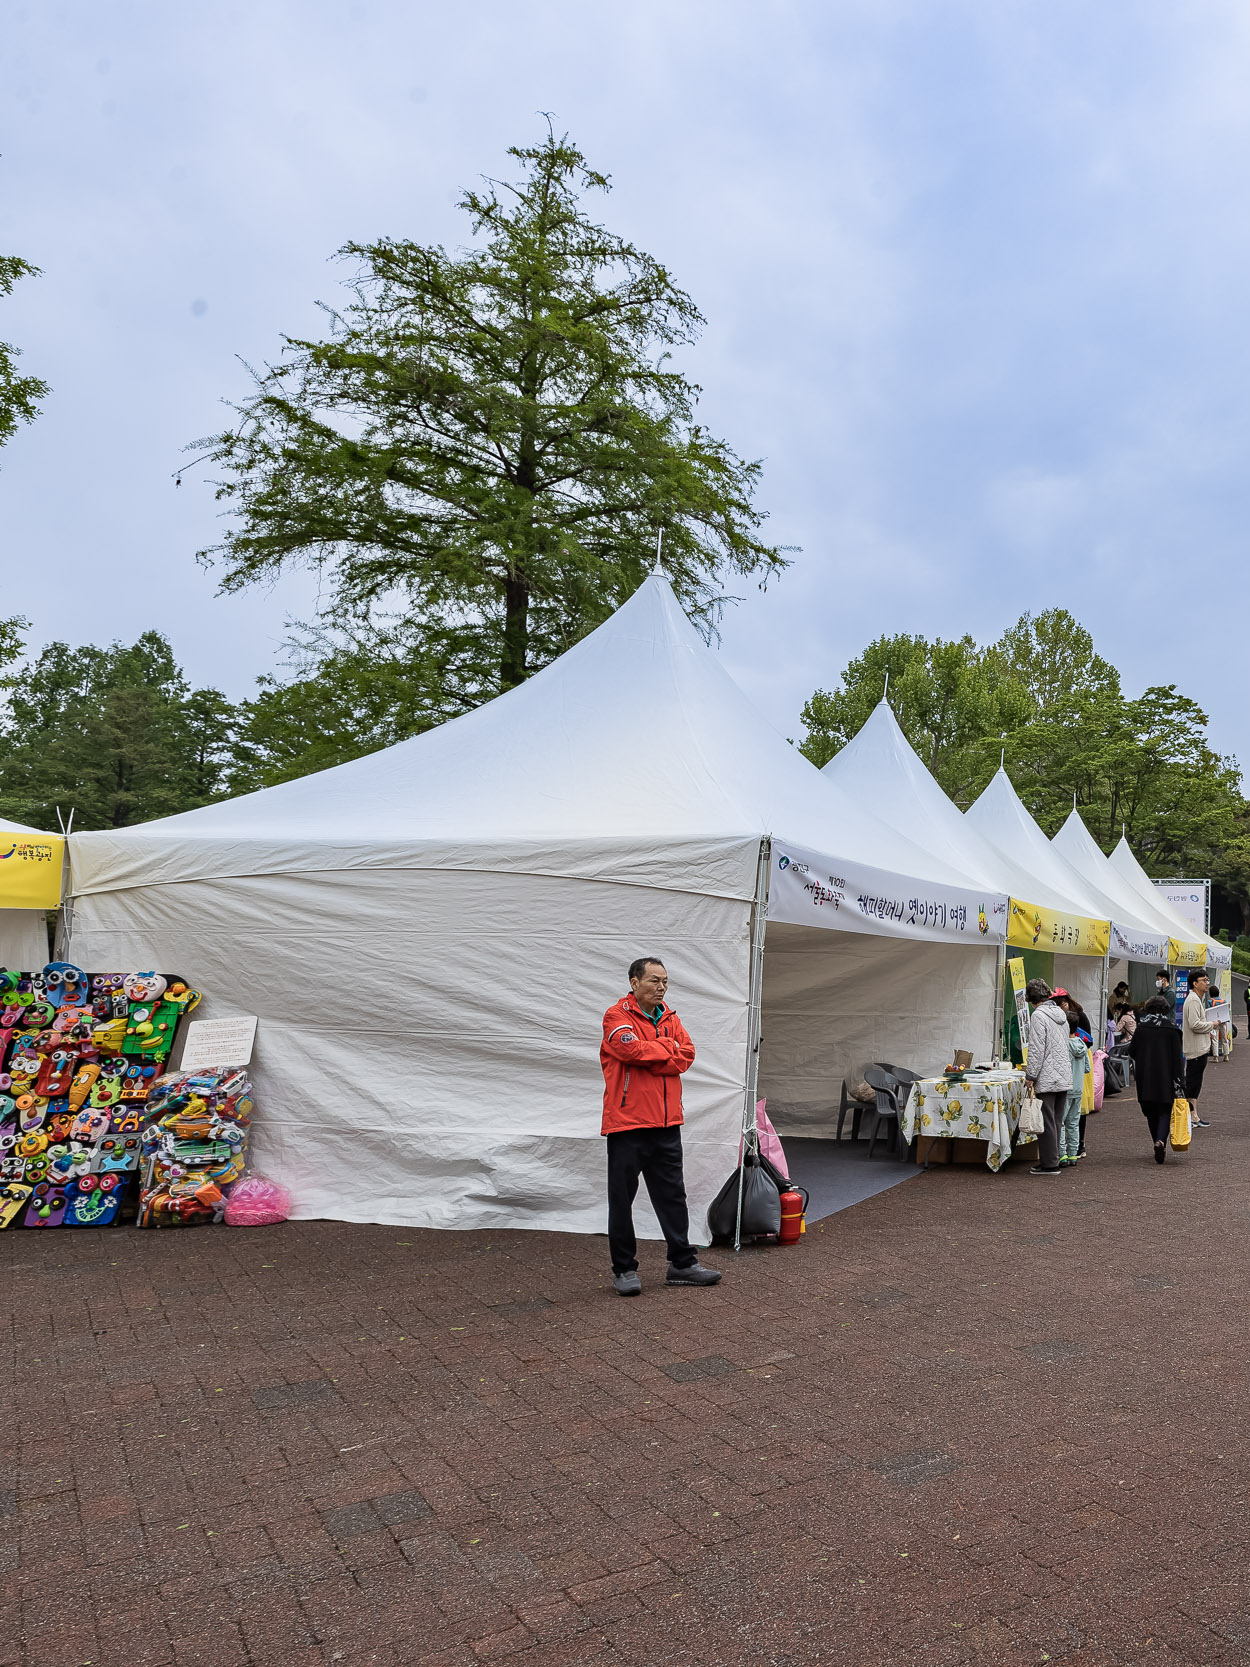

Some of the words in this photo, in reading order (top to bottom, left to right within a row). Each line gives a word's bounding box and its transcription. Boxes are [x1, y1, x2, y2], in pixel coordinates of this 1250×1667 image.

[18, 850, 52, 861] 행복광진
[791, 860, 810, 874] 광진구
[856, 894, 904, 922] 해피할머니
[906, 898, 947, 929] 옛이야기
[950, 905, 967, 931] 여행
